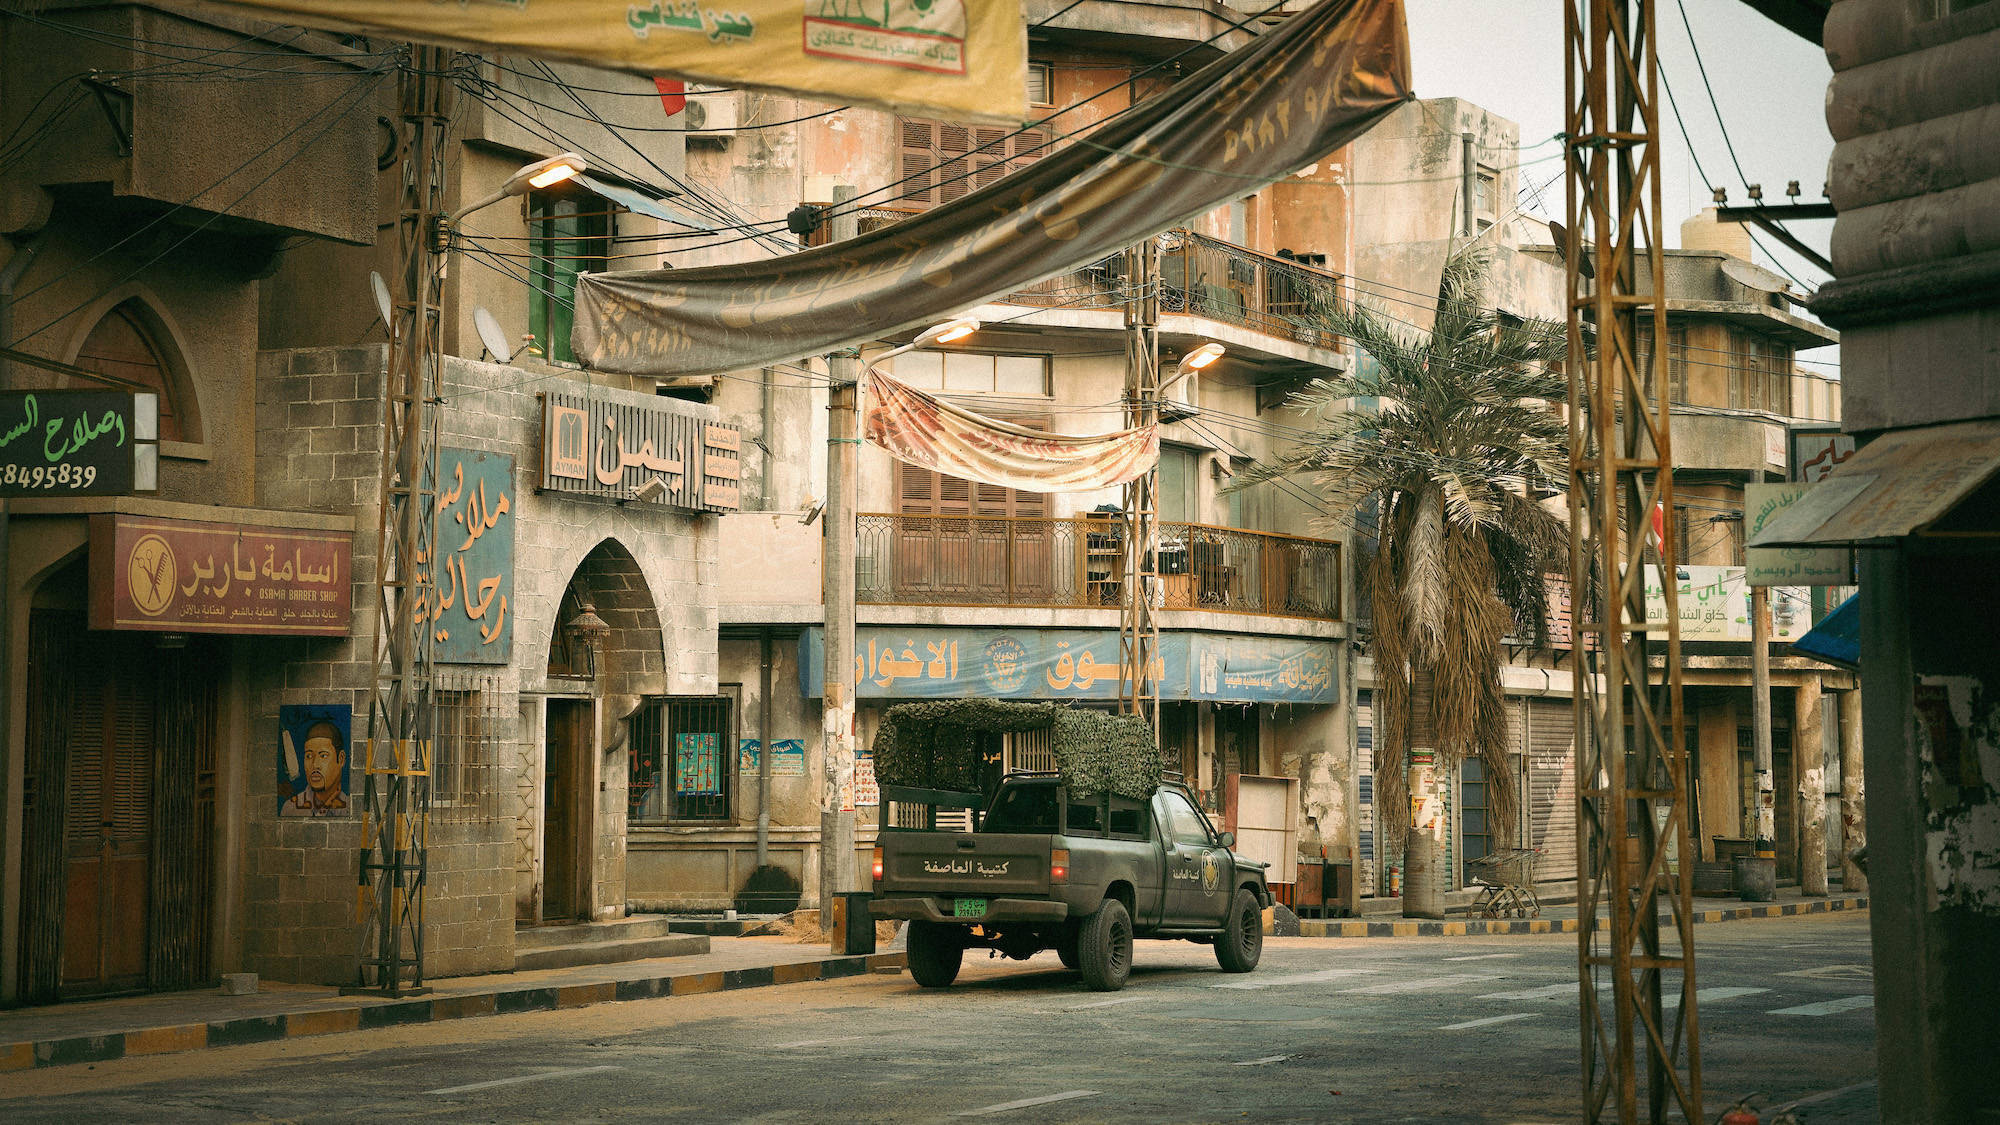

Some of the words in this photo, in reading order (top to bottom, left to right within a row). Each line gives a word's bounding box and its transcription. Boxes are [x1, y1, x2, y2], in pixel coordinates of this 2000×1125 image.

[707, 12, 753, 41] حجز
[860, 36, 919, 56] سفريات
[925, 44, 958, 63] شركة
[44, 410, 125, 462] اصلاح
[595, 415, 700, 496] ايمن
[0, 463, 97, 488] 8495839
[555, 461, 585, 476] AYMAN
[181, 540, 256, 598] باربر
[262, 544, 338, 585] اسامة
[260, 588, 286, 600] OSAMA
[289, 589, 317, 601] BARBER
[320, 591, 338, 602] SHOP
[1646, 607, 1663, 621] الفا
[1047, 641, 1165, 690] سوق
[924, 859, 973, 874] العاصفة
[976, 861, 1010, 877] كتيبة
